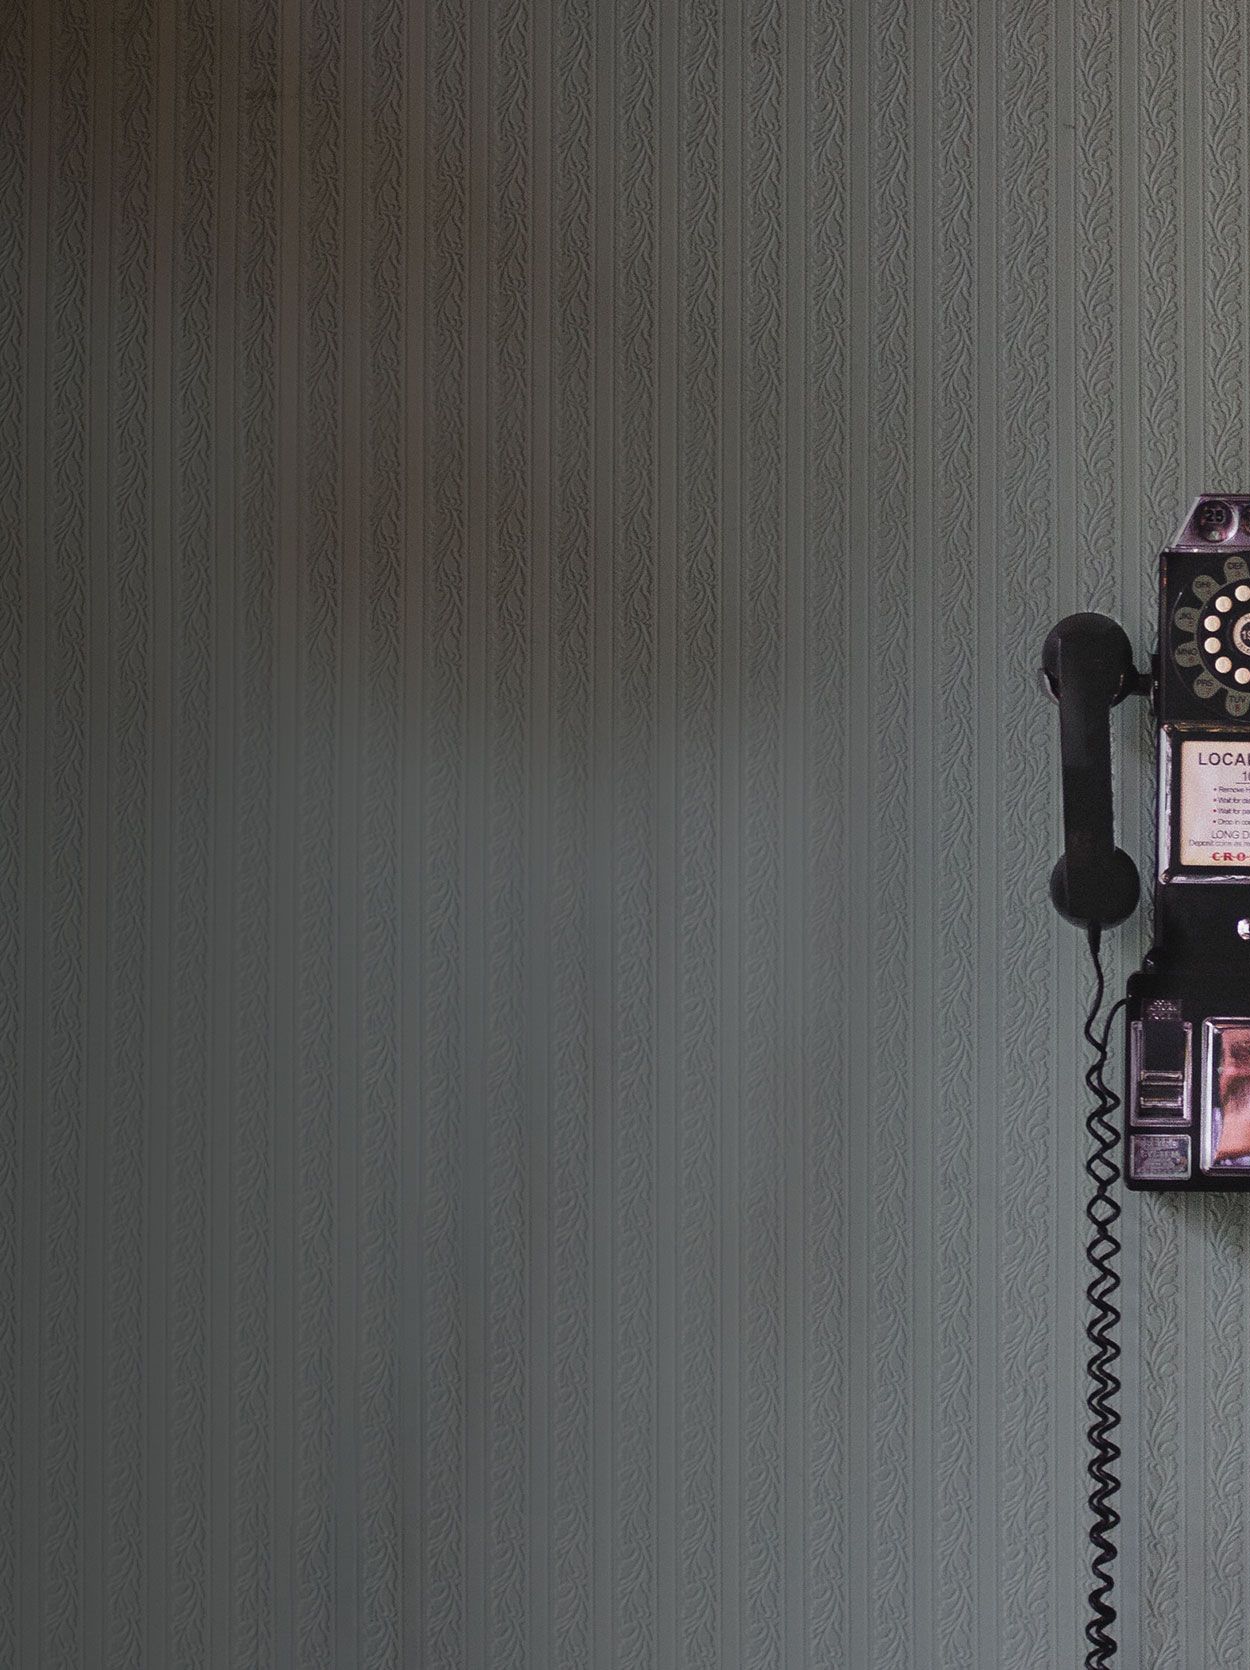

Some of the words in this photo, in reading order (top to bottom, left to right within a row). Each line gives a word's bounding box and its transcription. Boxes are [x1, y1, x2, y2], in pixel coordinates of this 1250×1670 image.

[1205, 509, 1225, 523] 25
[1217, 818, 1234, 826] Drop
[1211, 830, 1240, 839] LONG
